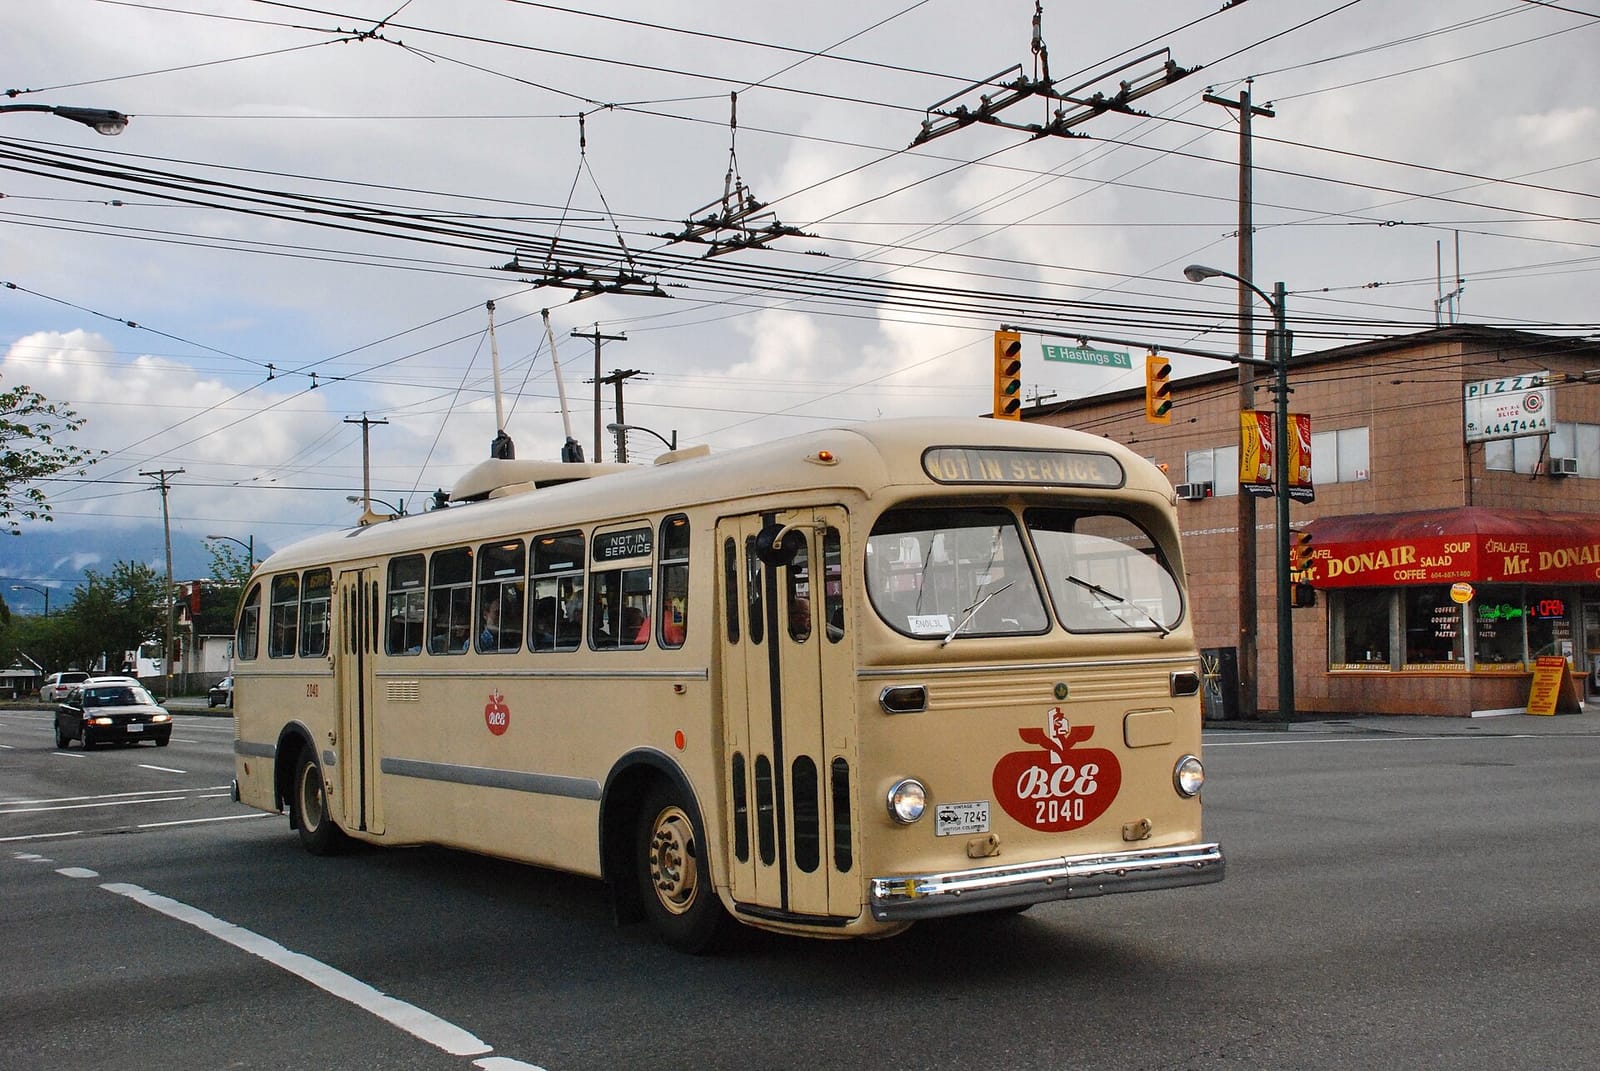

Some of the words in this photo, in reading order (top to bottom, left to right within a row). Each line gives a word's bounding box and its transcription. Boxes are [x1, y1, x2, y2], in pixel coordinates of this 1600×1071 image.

[1047, 346, 1056, 358] E
[1059, 348, 1109, 365] Hastings
[1113, 353, 1127, 365] St
[1485, 418, 1547, 435] 4447444
[928, 457, 970, 480] NOT
[978, 459, 1004, 480] IN
[1008, 458, 1103, 482] SERVICE
[610, 535, 632, 546] NOT
[635, 533, 646, 544] IN
[605, 543, 651, 557] SERVICE
[1444, 542, 1471, 554] SOUP
[1493, 542, 1530, 553] FALAFEL
[1327, 545, 1416, 578] DONAIR
[1420, 555, 1453, 567] SALAD
[1503, 555, 1533, 575] Mr.
[1393, 569, 1427, 580] COFFEE
[306, 683, 318, 697] 2040
[1017, 763, 1099, 799] BCE
[964, 810, 987, 822] 7245
[1035, 798, 1083, 823] 2040
